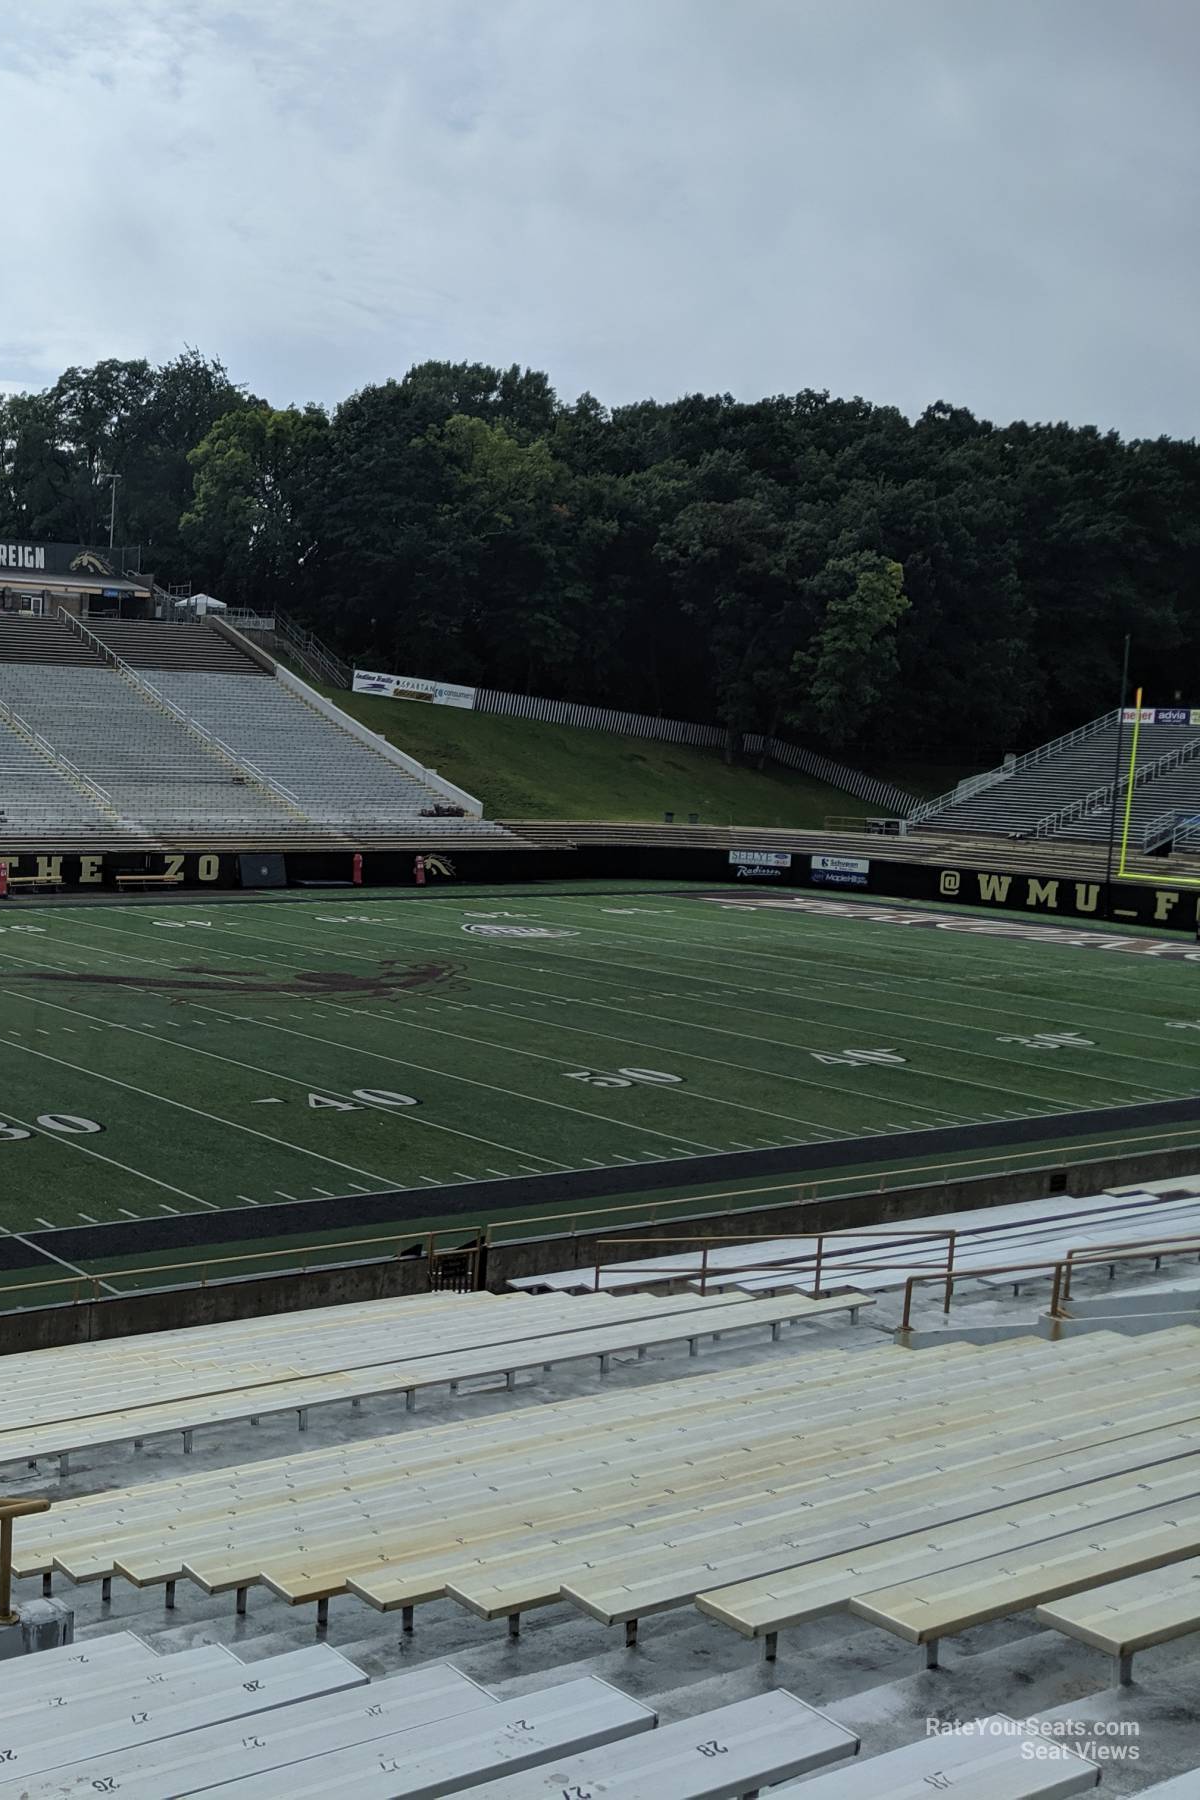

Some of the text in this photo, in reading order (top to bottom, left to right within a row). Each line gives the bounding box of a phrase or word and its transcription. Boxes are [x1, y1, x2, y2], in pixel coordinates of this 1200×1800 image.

[1158, 710, 1187, 720] advia
[737, 865, 783, 878] Radisson
[939, 870, 1200, 922] @WMU_F
[995, 1033, 1096, 1049] 30
[810, 1049, 907, 1066] 40
[560, 1068, 684, 1088] 50
[308, 1089, 418, 1111] 40
[242, 1679, 266, 1692] 28
[696, 1740, 729, 1758] 28
[91, 1777, 121, 1794] 26
